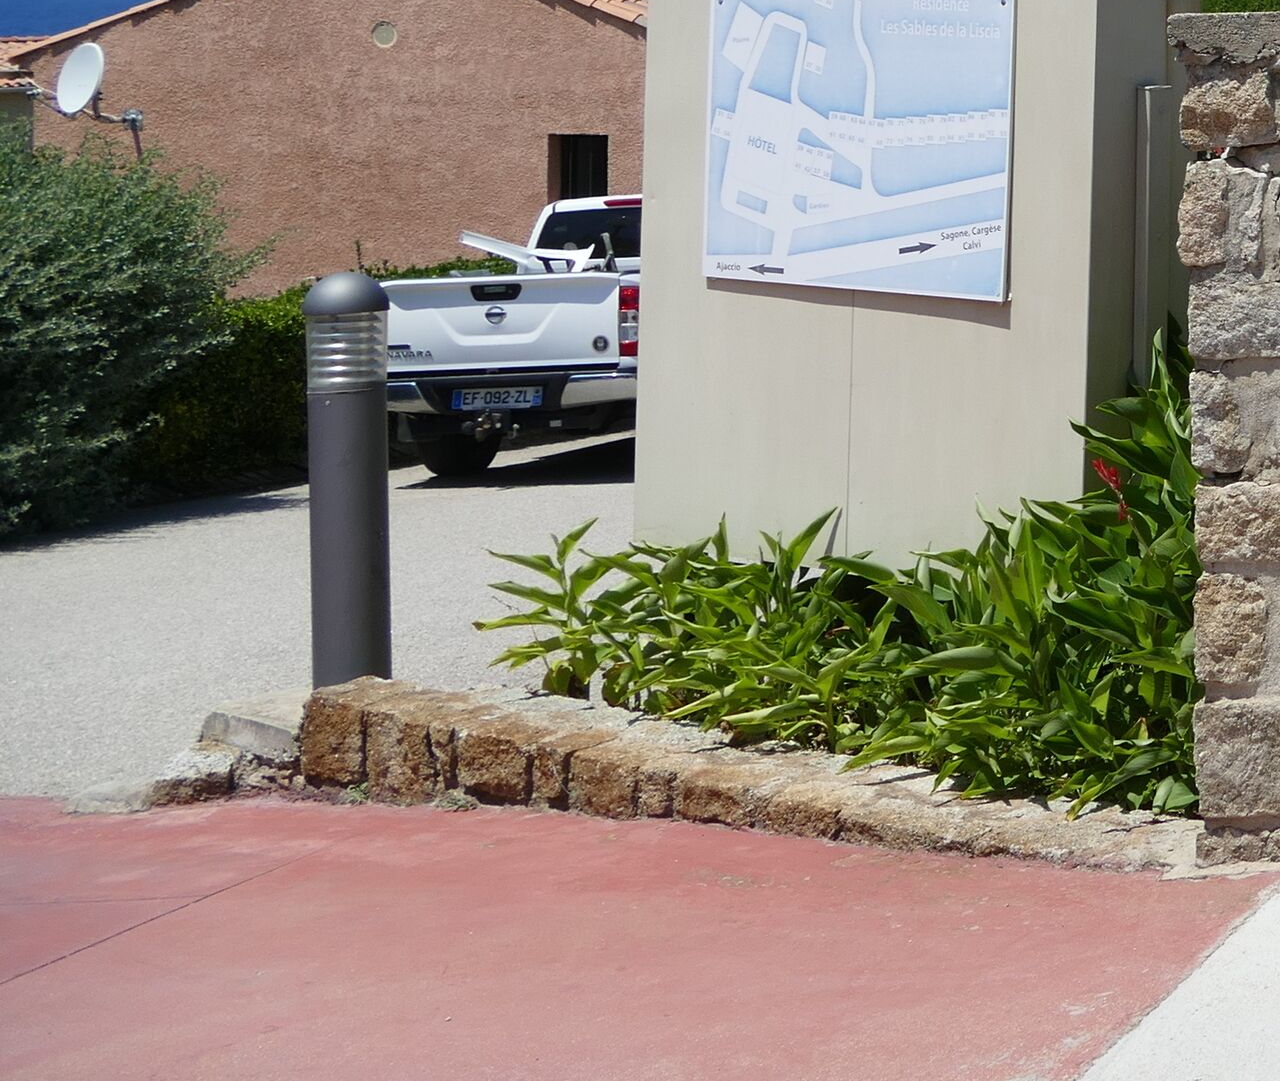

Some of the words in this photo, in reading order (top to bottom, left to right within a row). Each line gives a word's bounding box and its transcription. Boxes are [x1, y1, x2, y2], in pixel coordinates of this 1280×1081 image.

[881, 19, 899, 34] Les
[901, 19, 937, 36] Sables
[940, 20, 954, 37] de
[956, 20, 967, 37] la
[969, 22, 1001, 39] Liscia
[940, 229, 970, 241] Sagone,
[963, 238, 982, 250] Calvi
[716, 261, 741, 272] Ajaccio
[462, 390, 531, 406] EF-092-ZL
